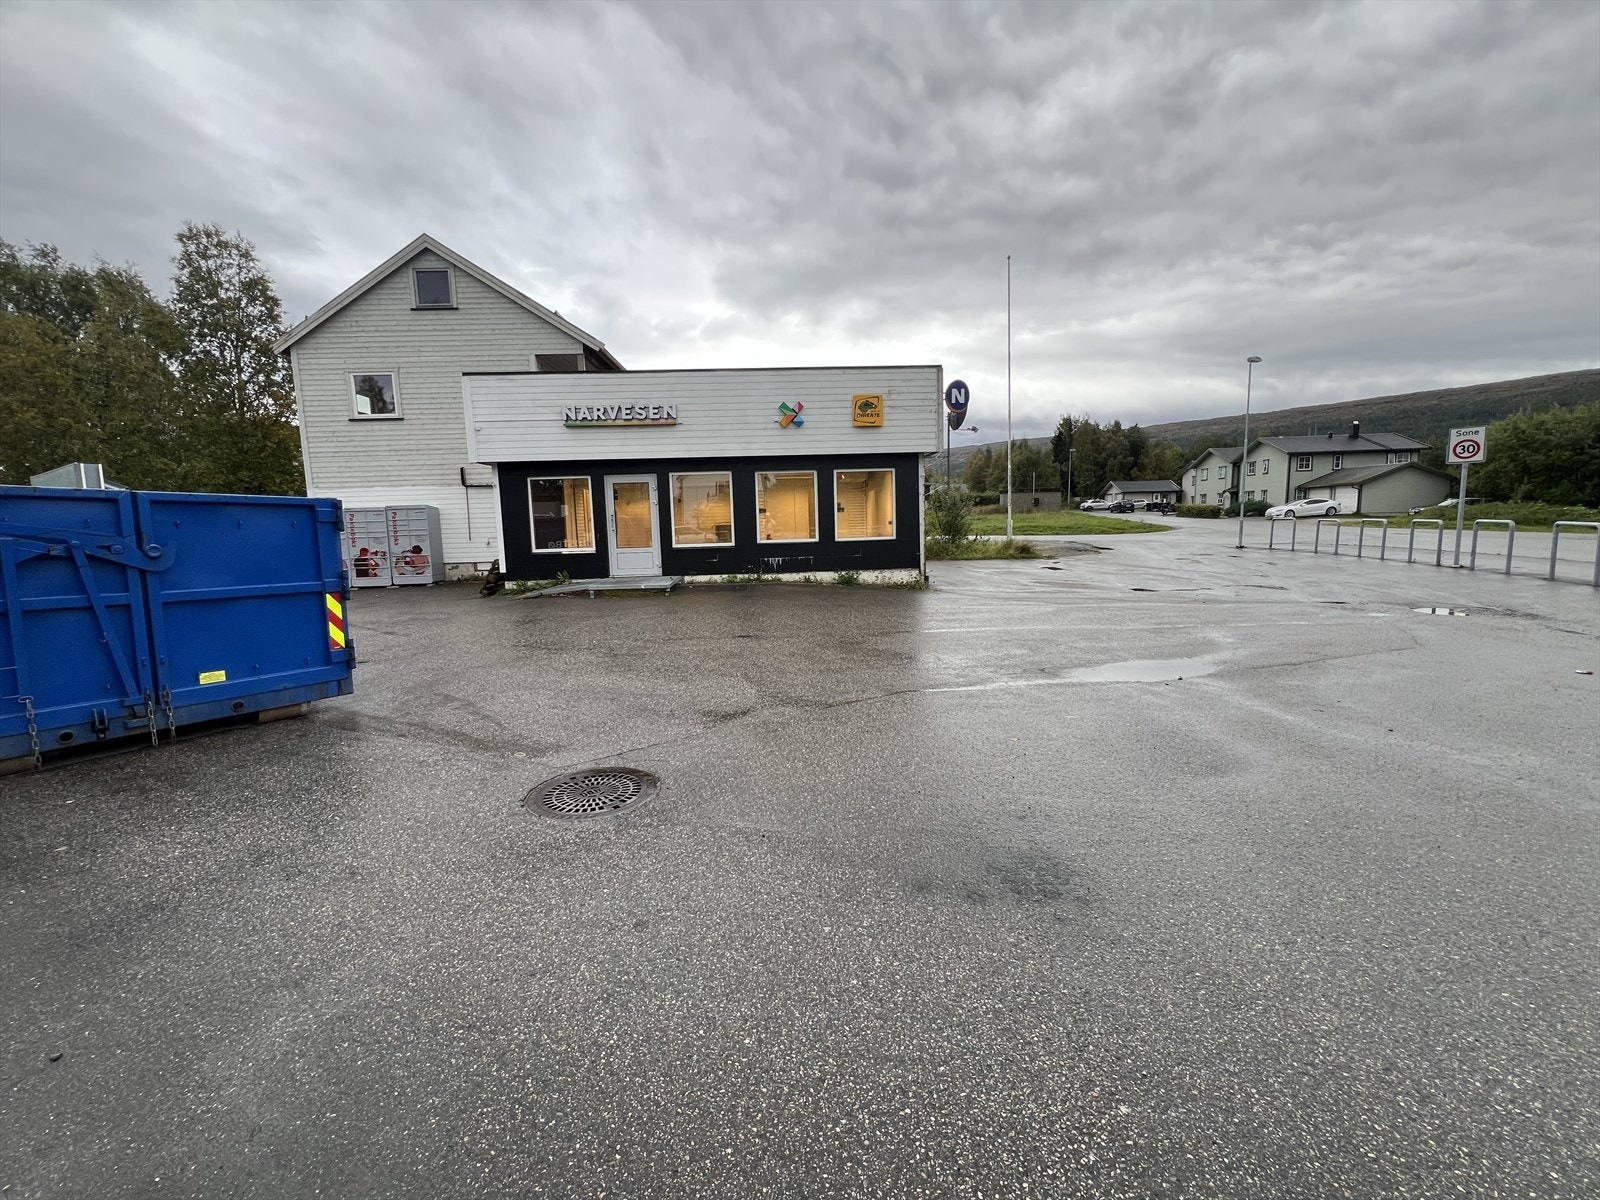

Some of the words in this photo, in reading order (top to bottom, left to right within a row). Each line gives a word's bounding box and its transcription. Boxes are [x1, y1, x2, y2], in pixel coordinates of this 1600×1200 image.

[951, 388, 966, 404] N
[562, 404, 677, 421] NARVESEN
[1458, 444, 1476, 455] 30
[348, 513, 356, 548] Pakkeboks
[391, 511, 399, 546] Pakkeboks
